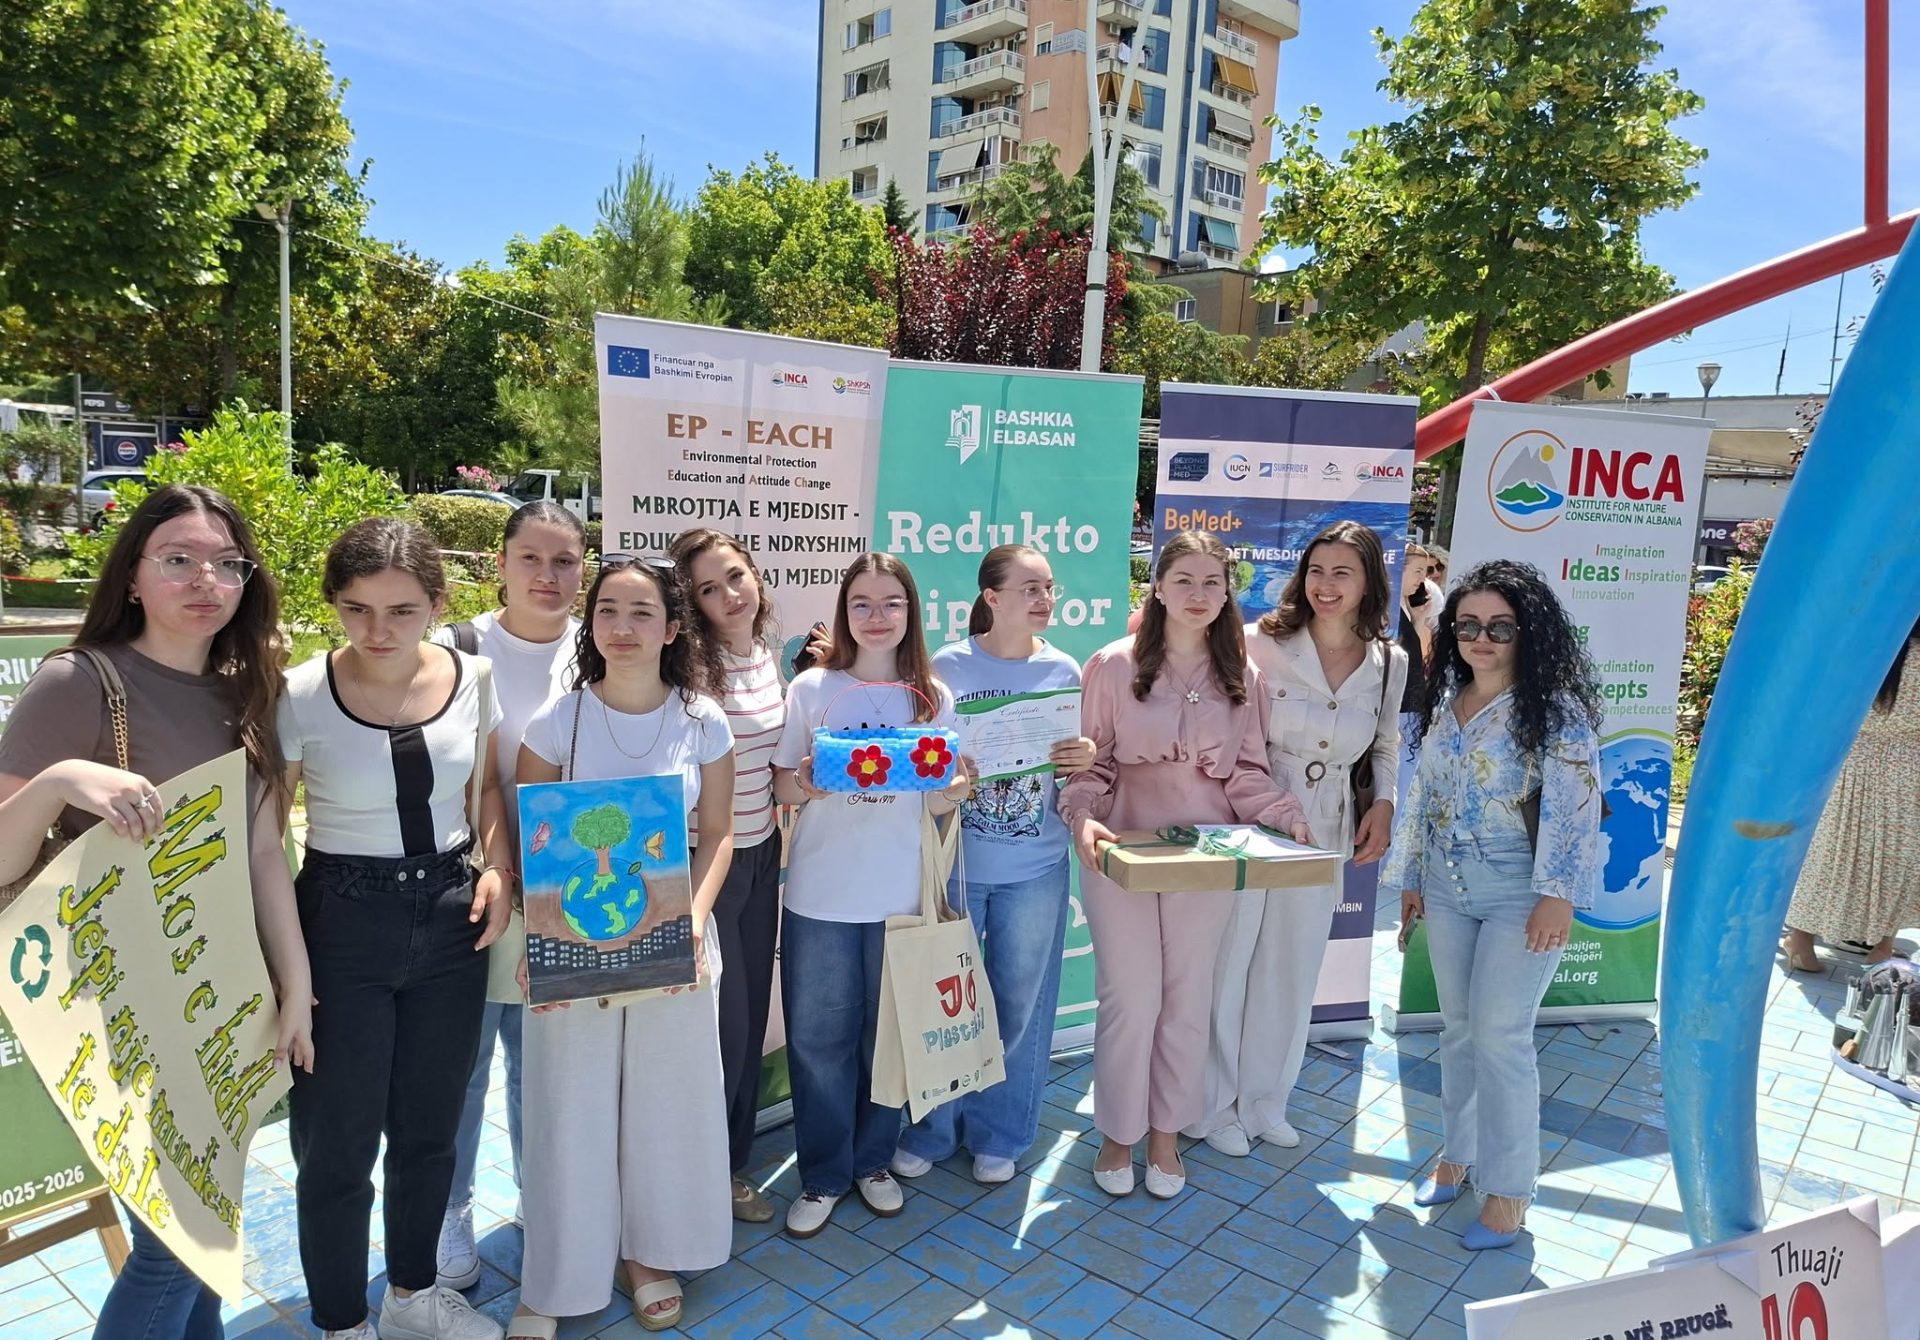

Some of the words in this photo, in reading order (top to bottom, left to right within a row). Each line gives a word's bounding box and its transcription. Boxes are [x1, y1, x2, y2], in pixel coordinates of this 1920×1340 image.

[654, 354, 696, 368] Financuar
[698, 360, 715, 369] nga
[654, 366, 693, 378] Bashkimi
[695, 371, 733, 383] Evropian
[784, 373, 808, 385] INCA
[995, 409, 1074, 428] BASHKIA
[667, 413, 707, 440] EP
[747, 420, 833, 450] EACH
[993, 430, 1076, 447] ELBASAN
[683, 450, 763, 465] Environmental
[765, 455, 817, 469] Protection
[1229, 464, 1251, 472] IUCN
[1273, 463, 1309, 473] SURFRIDER
[667, 469, 722, 484] Education
[726, 472, 745, 485] and
[749, 475, 790, 488] Attitude
[794, 477, 831, 491] Change
[1372, 465, 1404, 478] INCA
[1567, 447, 1685, 503] INCA
[632, 495, 742, 520] MBROJTJA
[750, 500, 760, 517] E
[768, 501, 848, 521] MJEDISIT
[1566, 499, 1611, 511] INSTITUTE
[1613, 501, 1631, 512] FOR
[1633, 503, 1666, 514] NATURE
[1164, 508, 1242, 532] BeMed+
[1565, 511, 1632, 524] CONSERVATION
[1634, 514, 1644, 524] IN
[1645, 515, 1682, 526] ALBANIA
[888, 511, 1099, 554] Redukto
[768, 534, 867, 553] NDRYSHIMI
[1596, 544, 1665, 559] Imagination
[1562, 559, 1620, 582] Ideas
[1625, 569, 1687, 584] Inspiration
[1571, 587, 1635, 601] Innovation
[1771, 1240, 1844, 1287] Thuaji
[1659, 1303, 1733, 1340] RRUGË,
